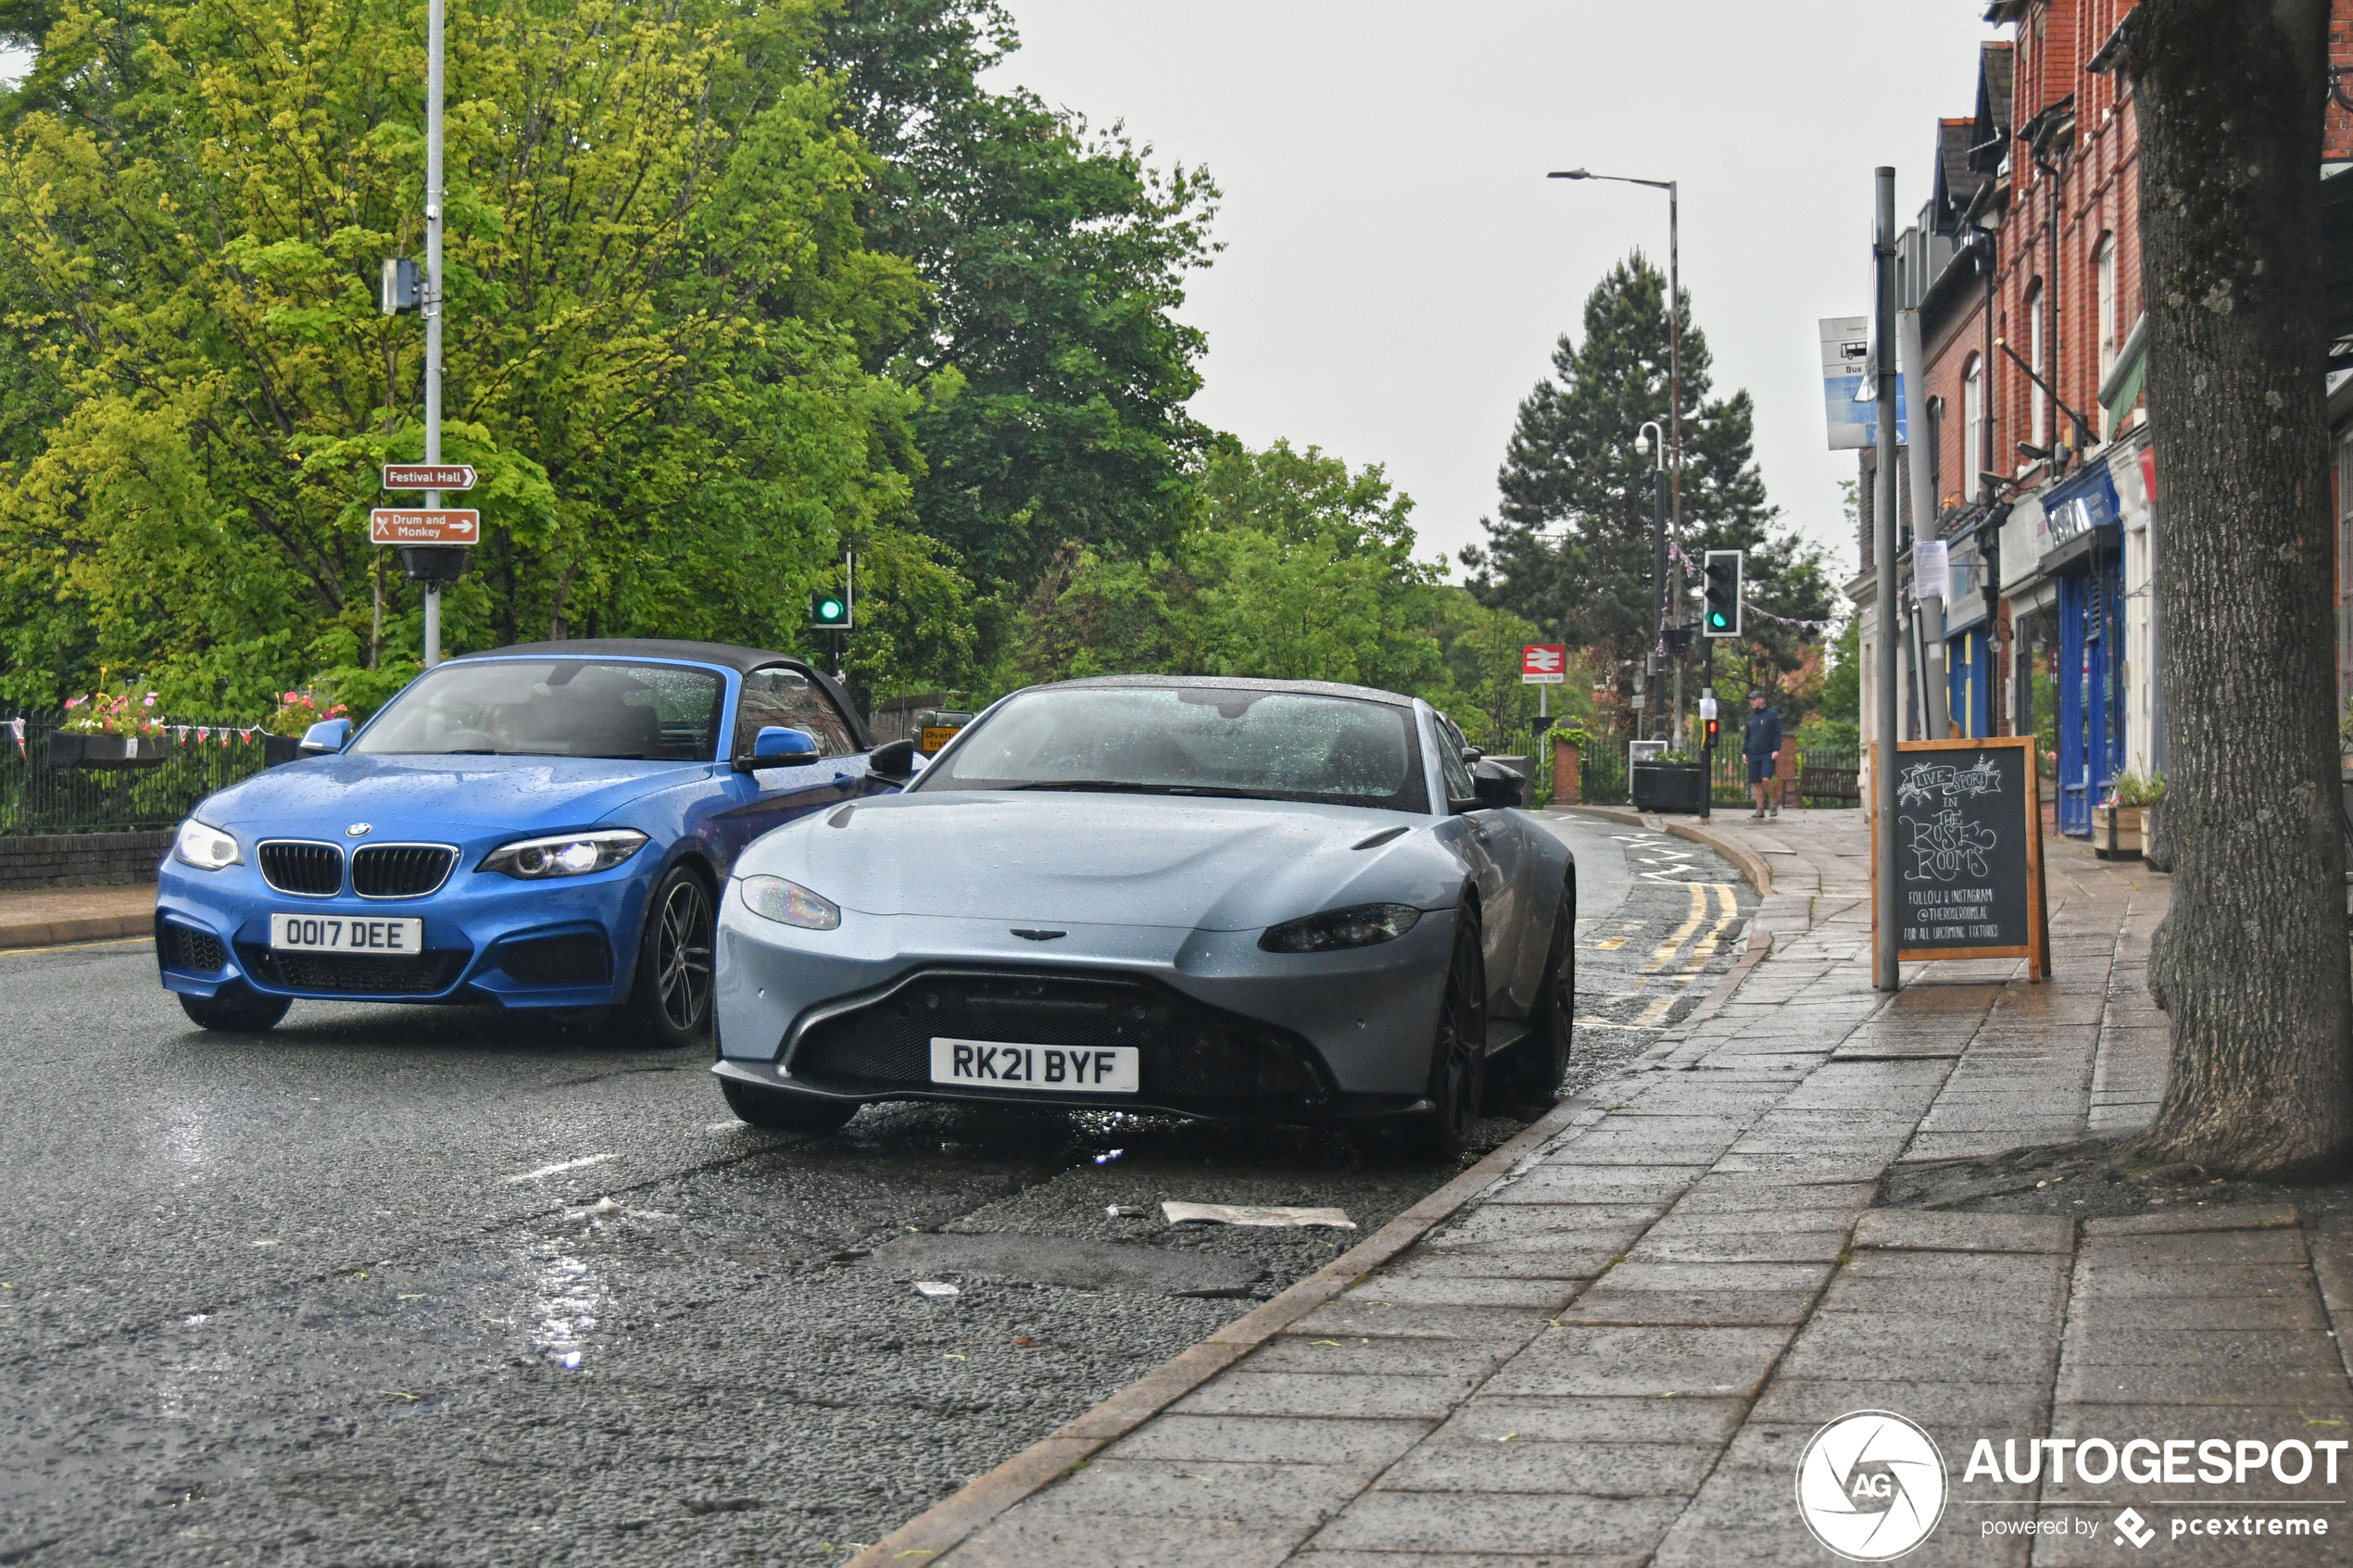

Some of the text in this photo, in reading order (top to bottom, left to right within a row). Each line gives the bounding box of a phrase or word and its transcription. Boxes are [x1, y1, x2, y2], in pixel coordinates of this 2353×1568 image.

[390, 471, 461, 483] Festival Hall
[393, 515, 447, 524] Drum and
[398, 527, 441, 538] Monkey
[1917, 771, 1985, 791] LIVE SPORT
[1943, 797, 1957, 807] IN
[1931, 809, 1963, 825] THE
[1898, 816, 1996, 851] ROSE
[1904, 847, 1988, 881] ROOMS
[1908, 890, 1941, 905] FOLLOW
[1951, 888, 1993, 903] INSTAGRAM
[1917, 906, 1988, 922] @THEROSEROOMS.AE
[351, 922, 404, 948] DEE
[1904, 924, 1999, 940] FOR ALL UPCOMING FIXTURES
[953, 1045, 1116, 1084] RK21 BYF
